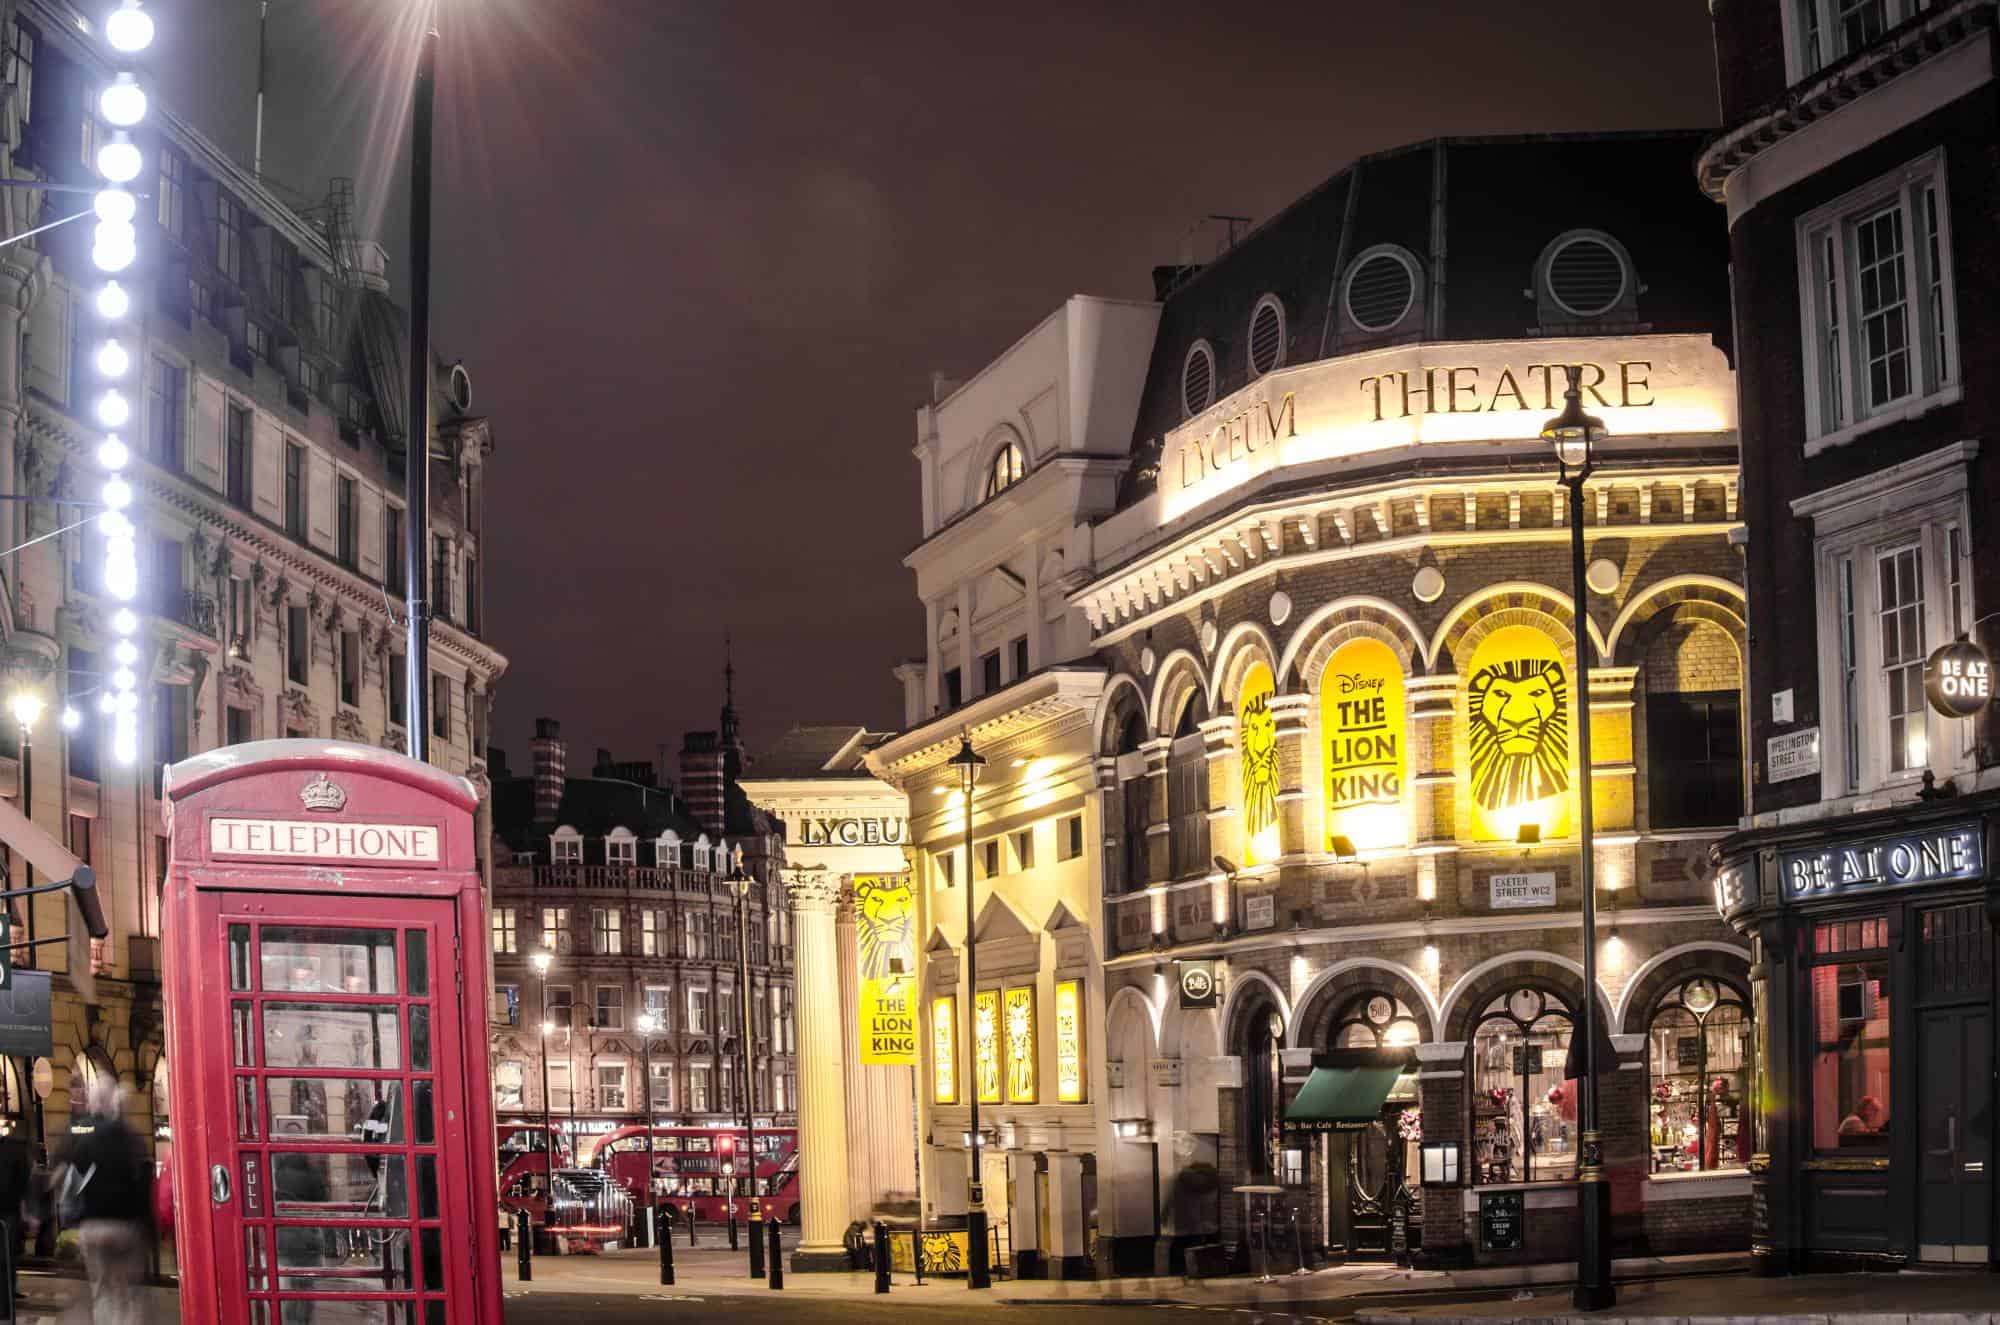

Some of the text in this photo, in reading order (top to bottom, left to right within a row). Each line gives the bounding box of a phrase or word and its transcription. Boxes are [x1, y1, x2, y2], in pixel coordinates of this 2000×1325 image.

[1360, 361, 1656, 421] THEATRE
[1942, 660, 1988, 678] BE AT
[1942, 677, 1988, 697] ONE
[1337, 697, 1386, 726] THE
[1331, 734, 1397, 764] LION
[1771, 751, 1795, 768] STREET
[1331, 772, 1399, 802] KING
[219, 823, 429, 857] TELEPHONE
[799, 817, 909, 845] LYCEU
[1791, 855, 1834, 892] BE
[1841, 847, 1886, 886] AT
[1890, 834, 1974, 880] ONE
[1495, 877, 1528, 888] EXETER
[1495, 886, 1551, 897] STREET WC2
[876, 999, 905, 1012] THE
[872, 1018, 912, 1031] LION
[872, 1038, 914, 1051] KING
[246, 1161, 258, 1208] PULL
